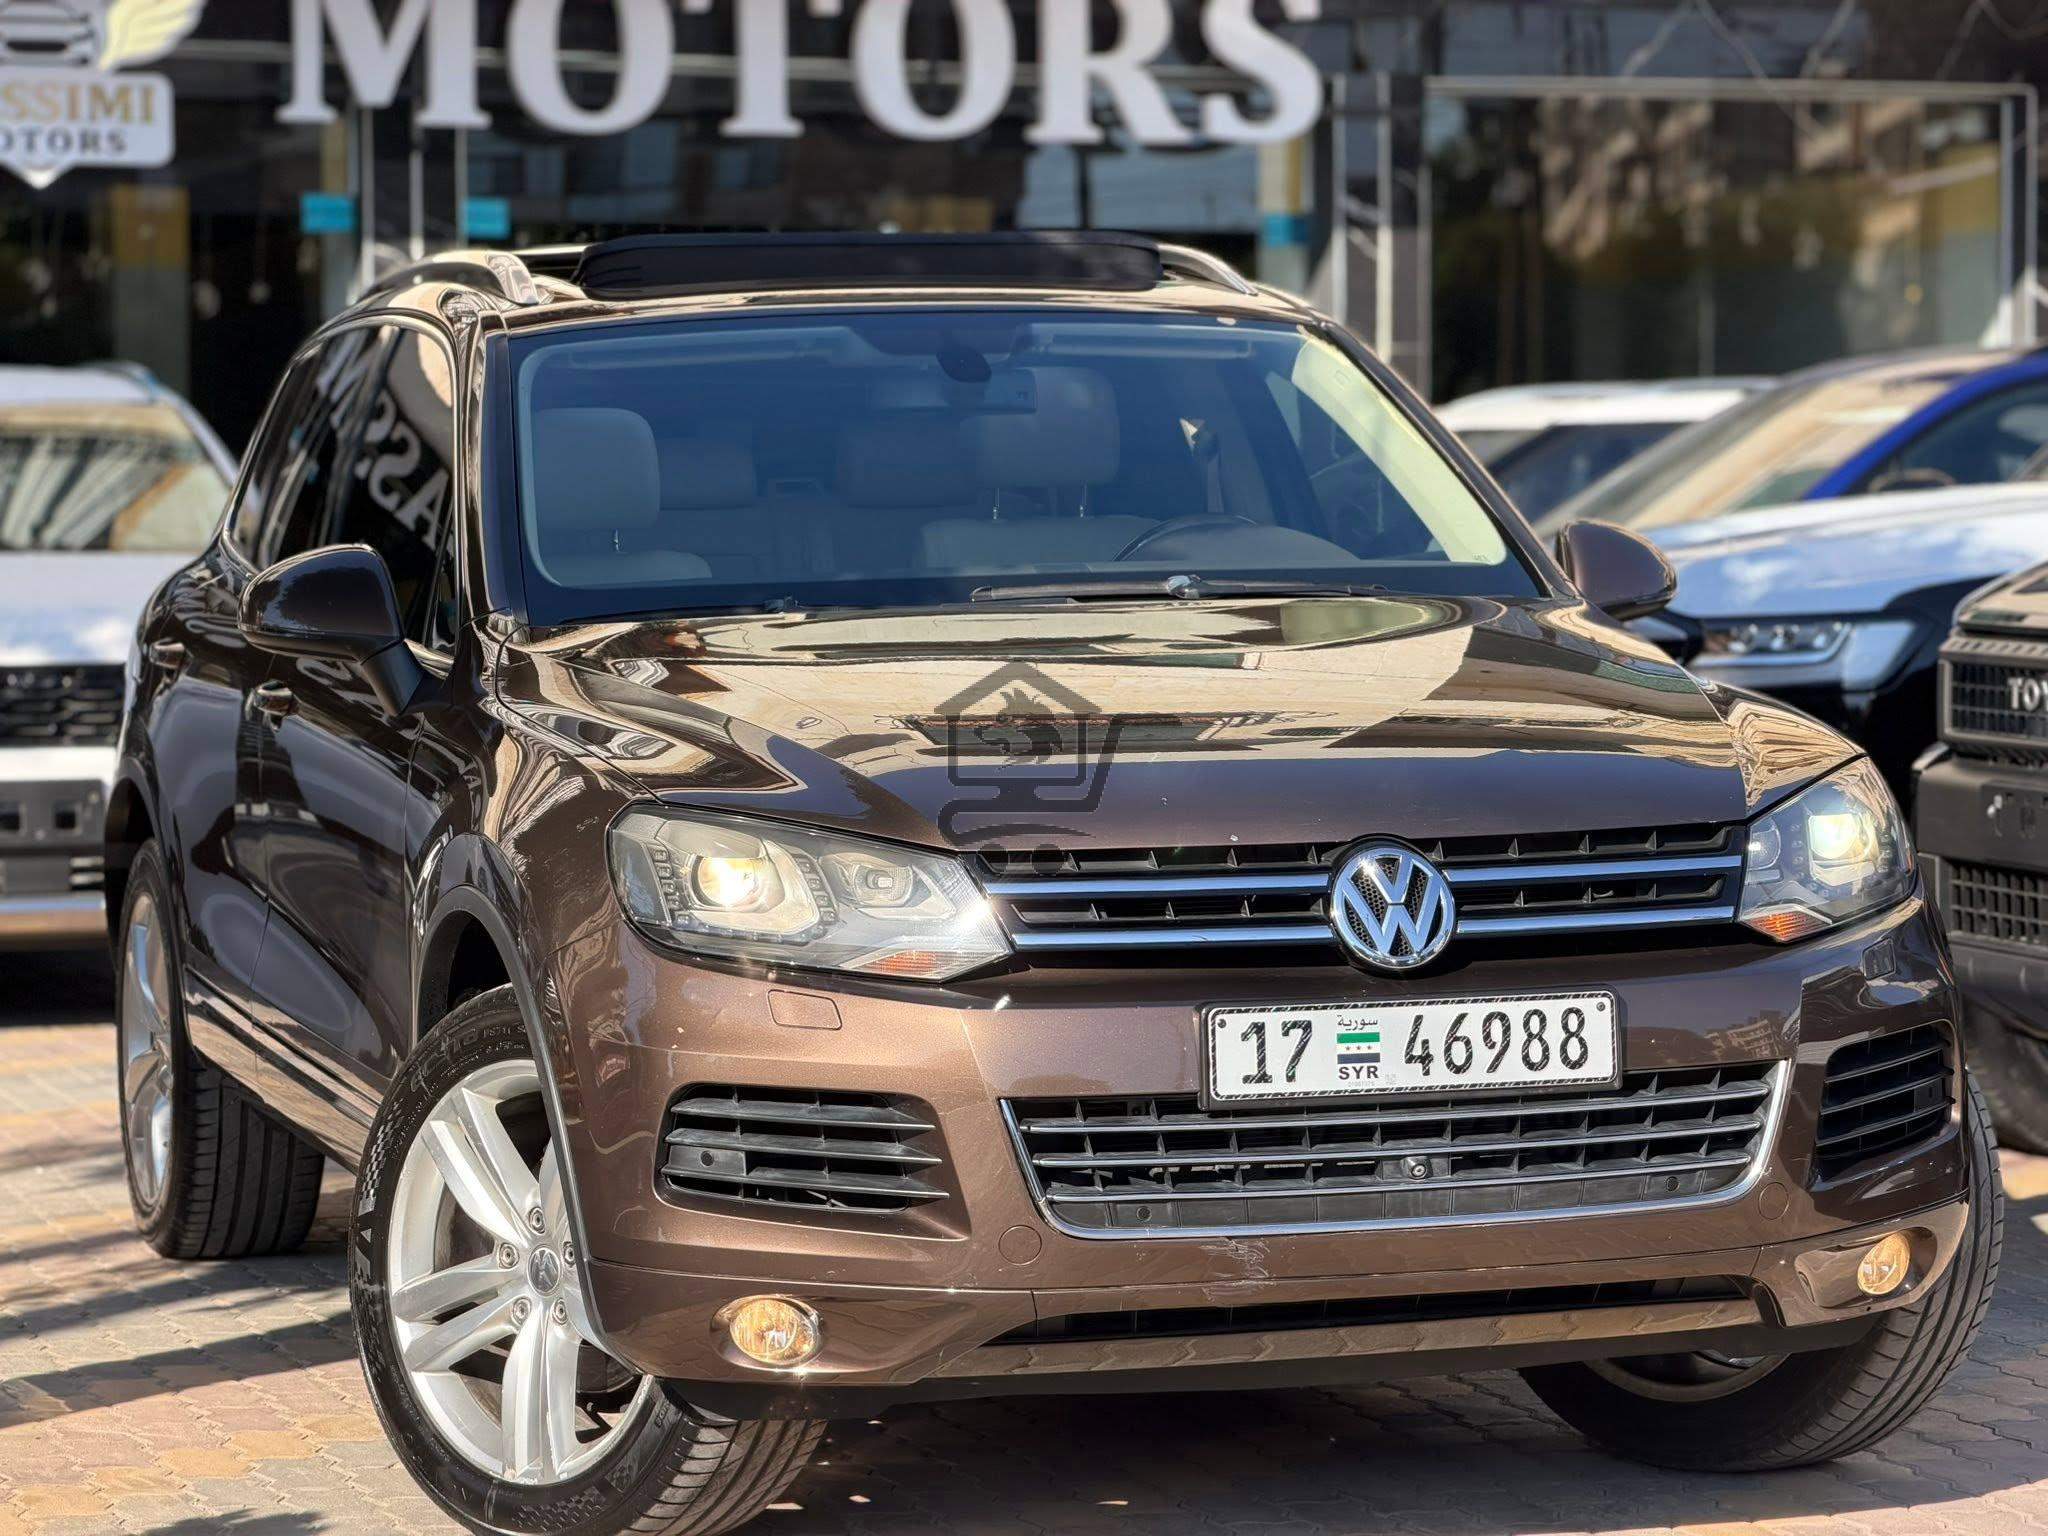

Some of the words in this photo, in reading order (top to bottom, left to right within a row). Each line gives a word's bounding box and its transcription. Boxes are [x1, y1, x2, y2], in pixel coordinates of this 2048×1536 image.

[277, 0, 1323, 146] MOTORS
[1241, 1019, 1313, 1084] 17
[1404, 1007, 1589, 1077] 46988
[1337, 1014, 1379, 1031] سورية
[1338, 1065, 1379, 1080] SYR
